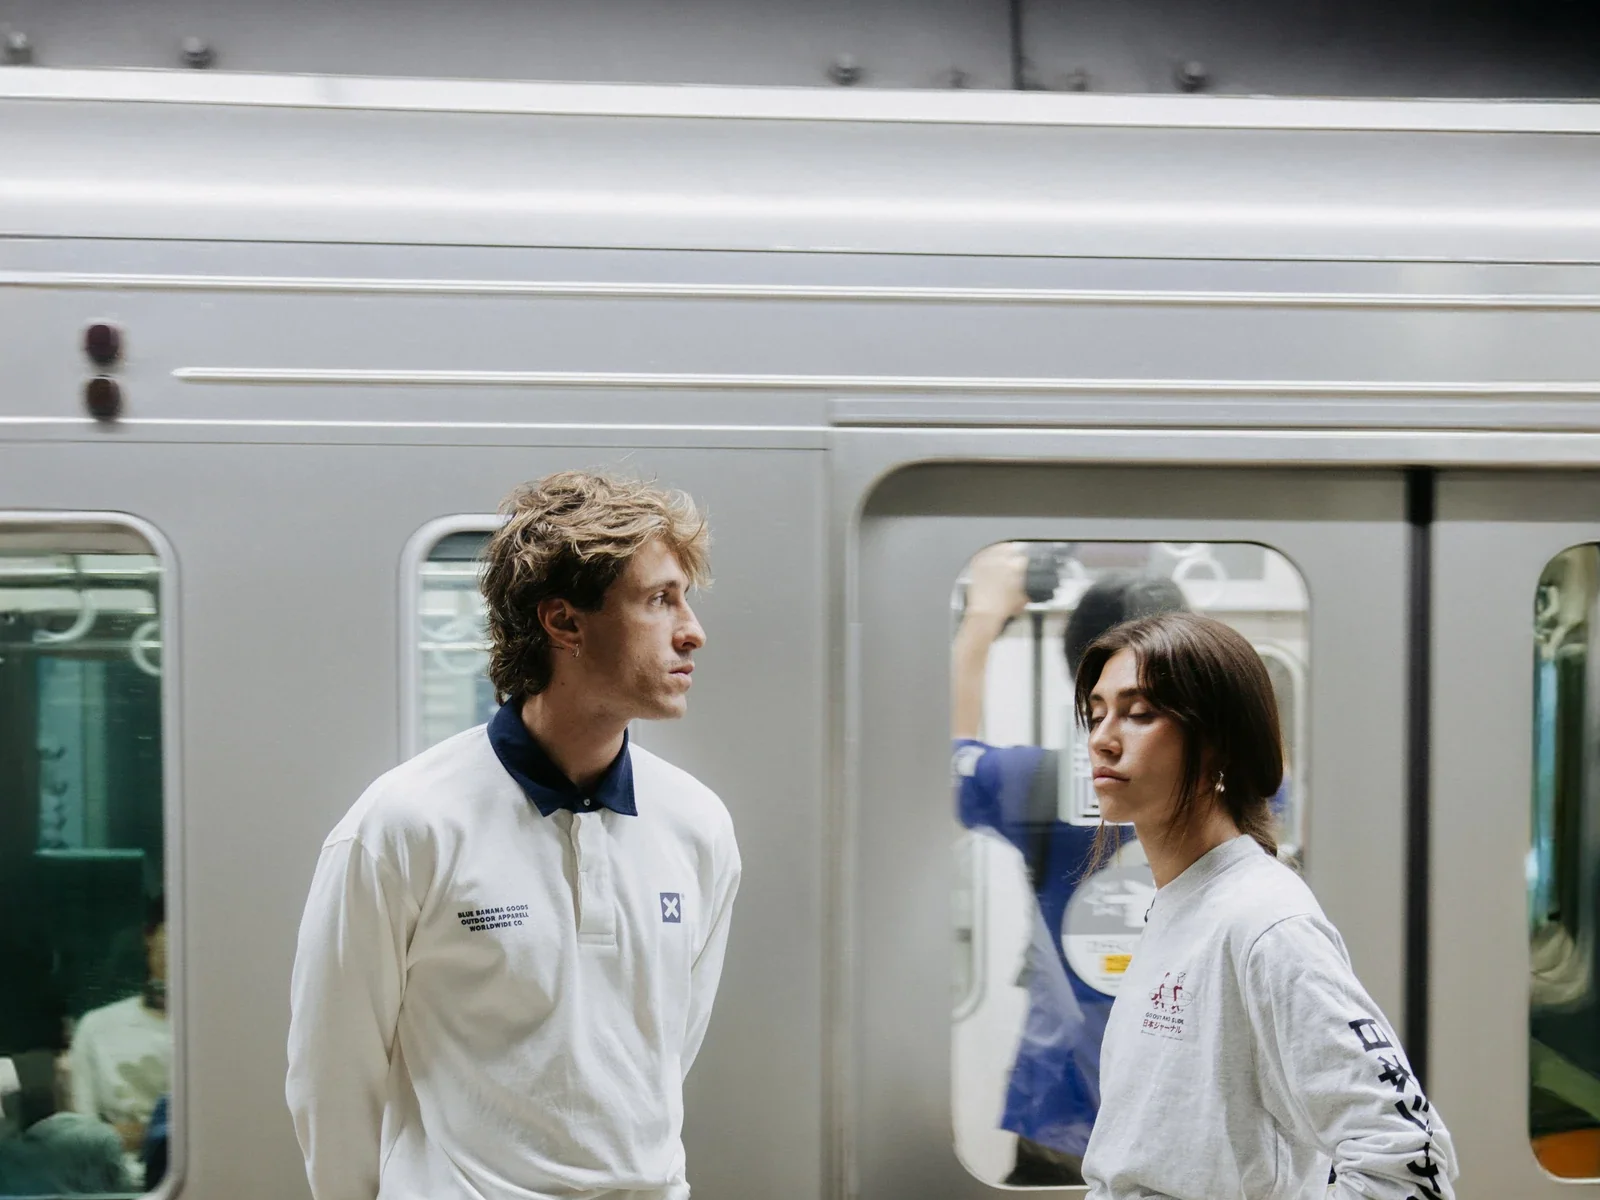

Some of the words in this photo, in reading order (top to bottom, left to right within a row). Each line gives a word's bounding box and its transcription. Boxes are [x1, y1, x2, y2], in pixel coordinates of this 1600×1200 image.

[476, 907, 505, 916] BANANA
[506, 904, 529, 912] GOODS
[461, 916, 496, 925] OUTDOOR
[498, 912, 529, 921] APPARELL
[469, 921, 512, 932] WORLDWIDE
[1143, 1019, 1182, 1034] 日本ジャーナル
